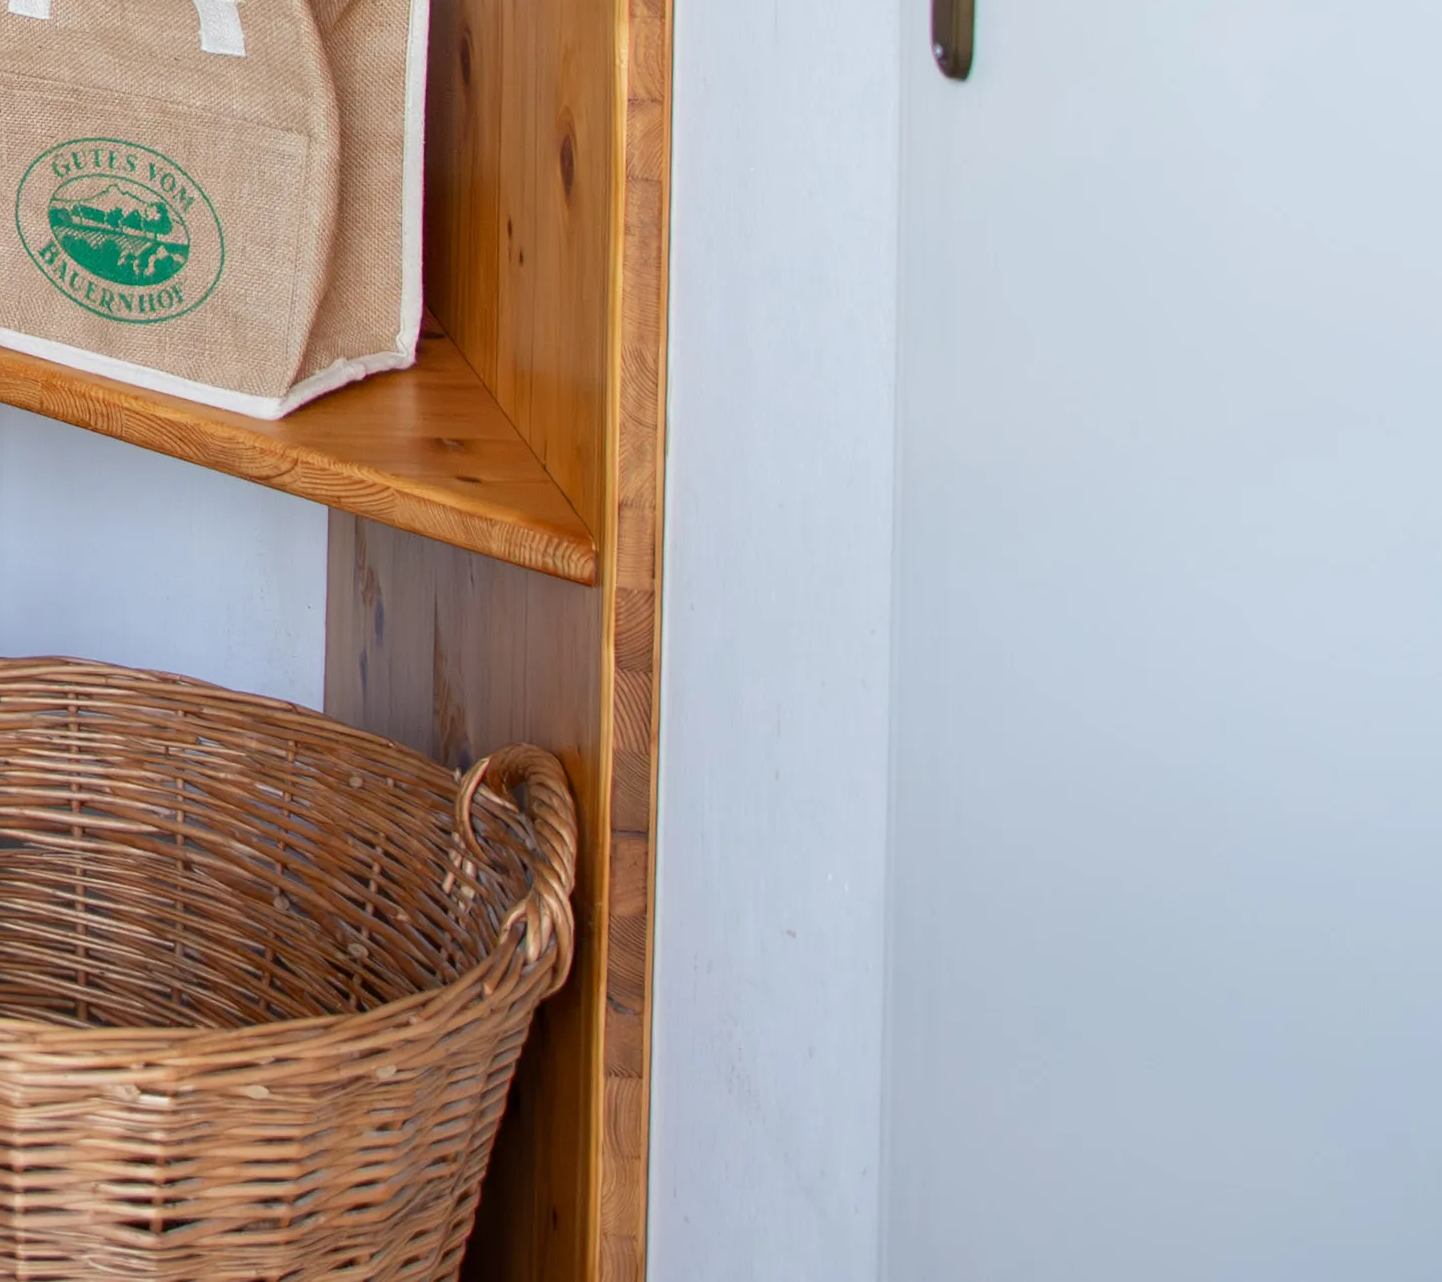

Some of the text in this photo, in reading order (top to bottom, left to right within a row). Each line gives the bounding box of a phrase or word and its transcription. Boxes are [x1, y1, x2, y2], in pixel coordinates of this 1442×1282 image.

[50, 148, 195, 214] GUTES VOM
[37, 239, 185, 314] BAUERNHOF
